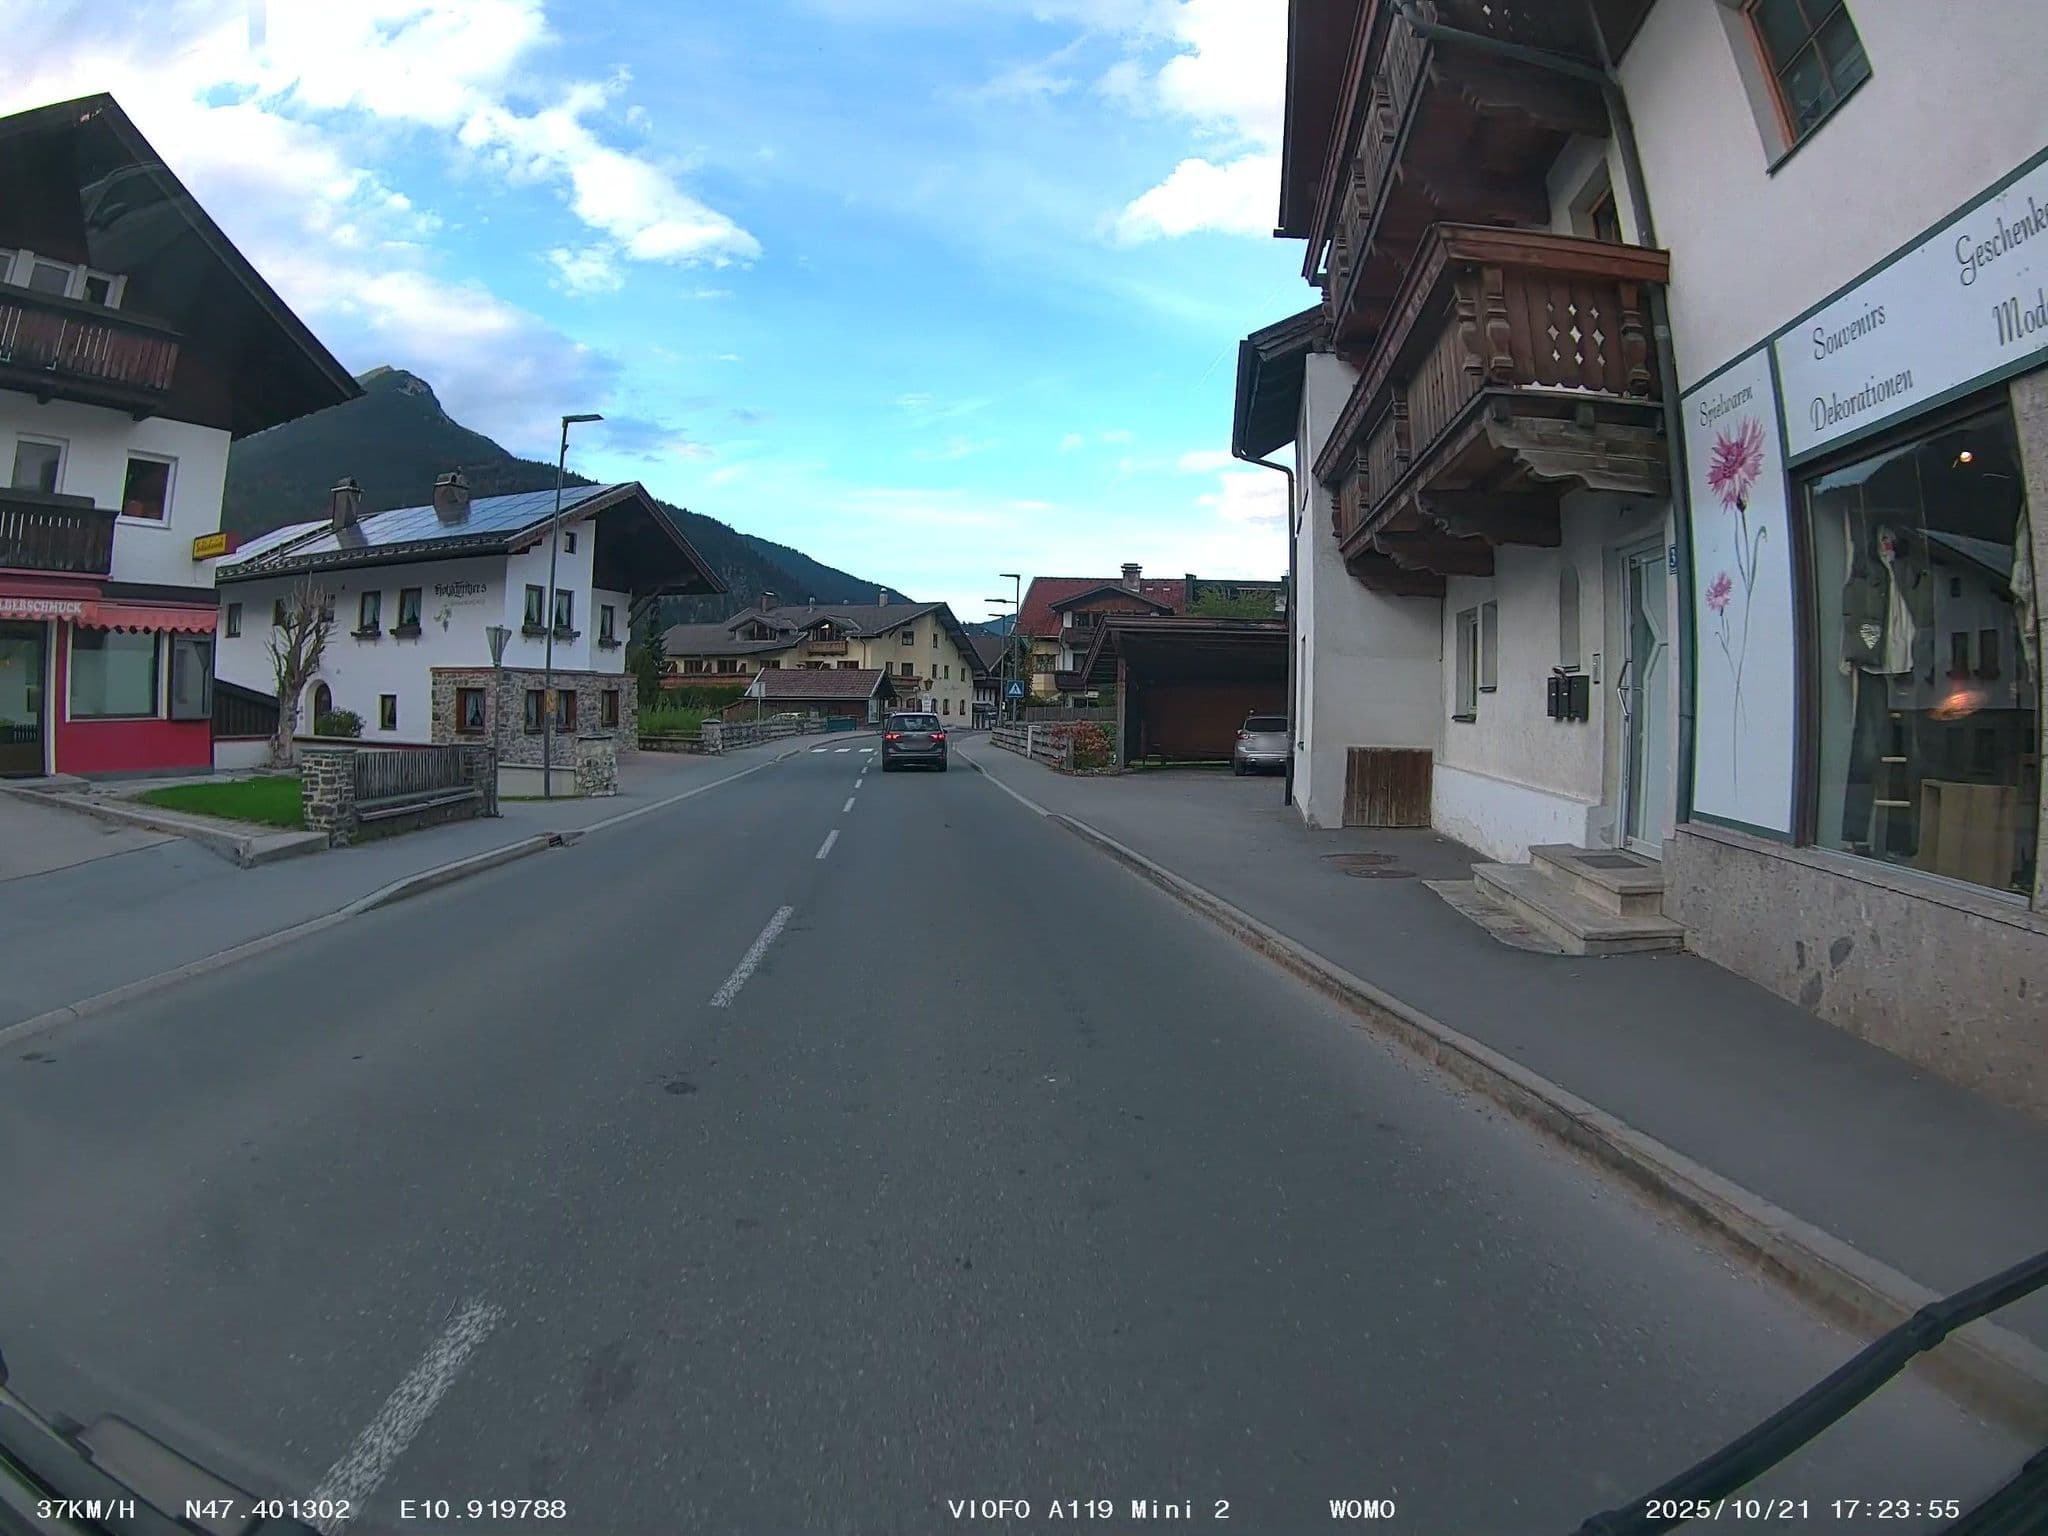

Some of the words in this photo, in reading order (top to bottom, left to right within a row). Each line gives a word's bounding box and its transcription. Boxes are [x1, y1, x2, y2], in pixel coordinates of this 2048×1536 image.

[1812, 303, 1886, 360] Souvenirs
[1992, 287, 2048, 346] Mod
[1699, 385, 1753, 428] Spielwaren
[1810, 369, 1914, 432] Dekorationen
